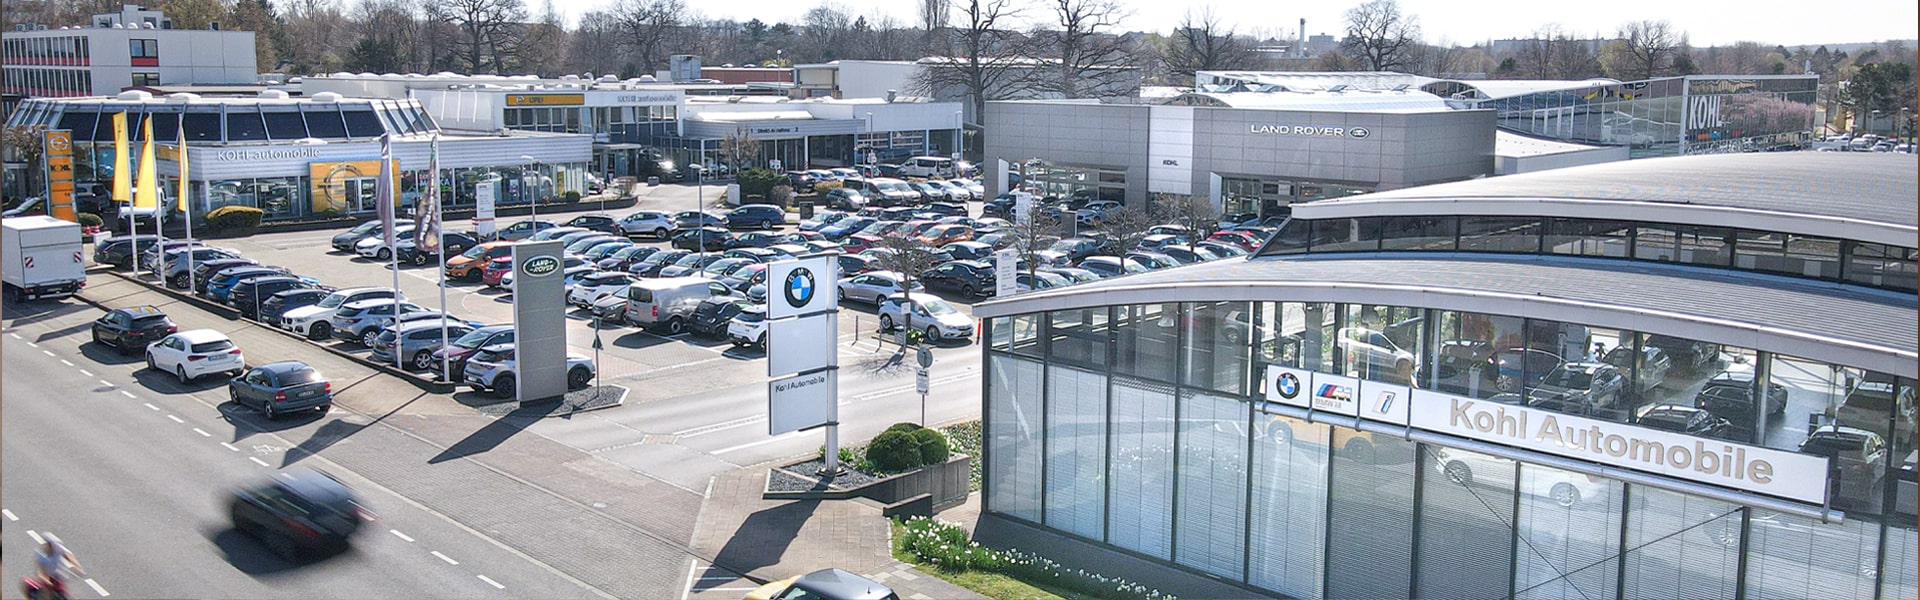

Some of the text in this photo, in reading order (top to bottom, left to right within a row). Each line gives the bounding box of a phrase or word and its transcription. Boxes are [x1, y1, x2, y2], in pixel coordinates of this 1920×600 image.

[1689, 95, 1722, 130] KOHL
[1250, 124, 1290, 134] LAND
[1293, 126, 1344, 137] ROVER
[217, 147, 321, 161] KOHL automobile
[532, 259, 549, 267] LAND
[533, 264, 554, 273] ROVER
[1449, 398, 1774, 485] Kohl Automobile
